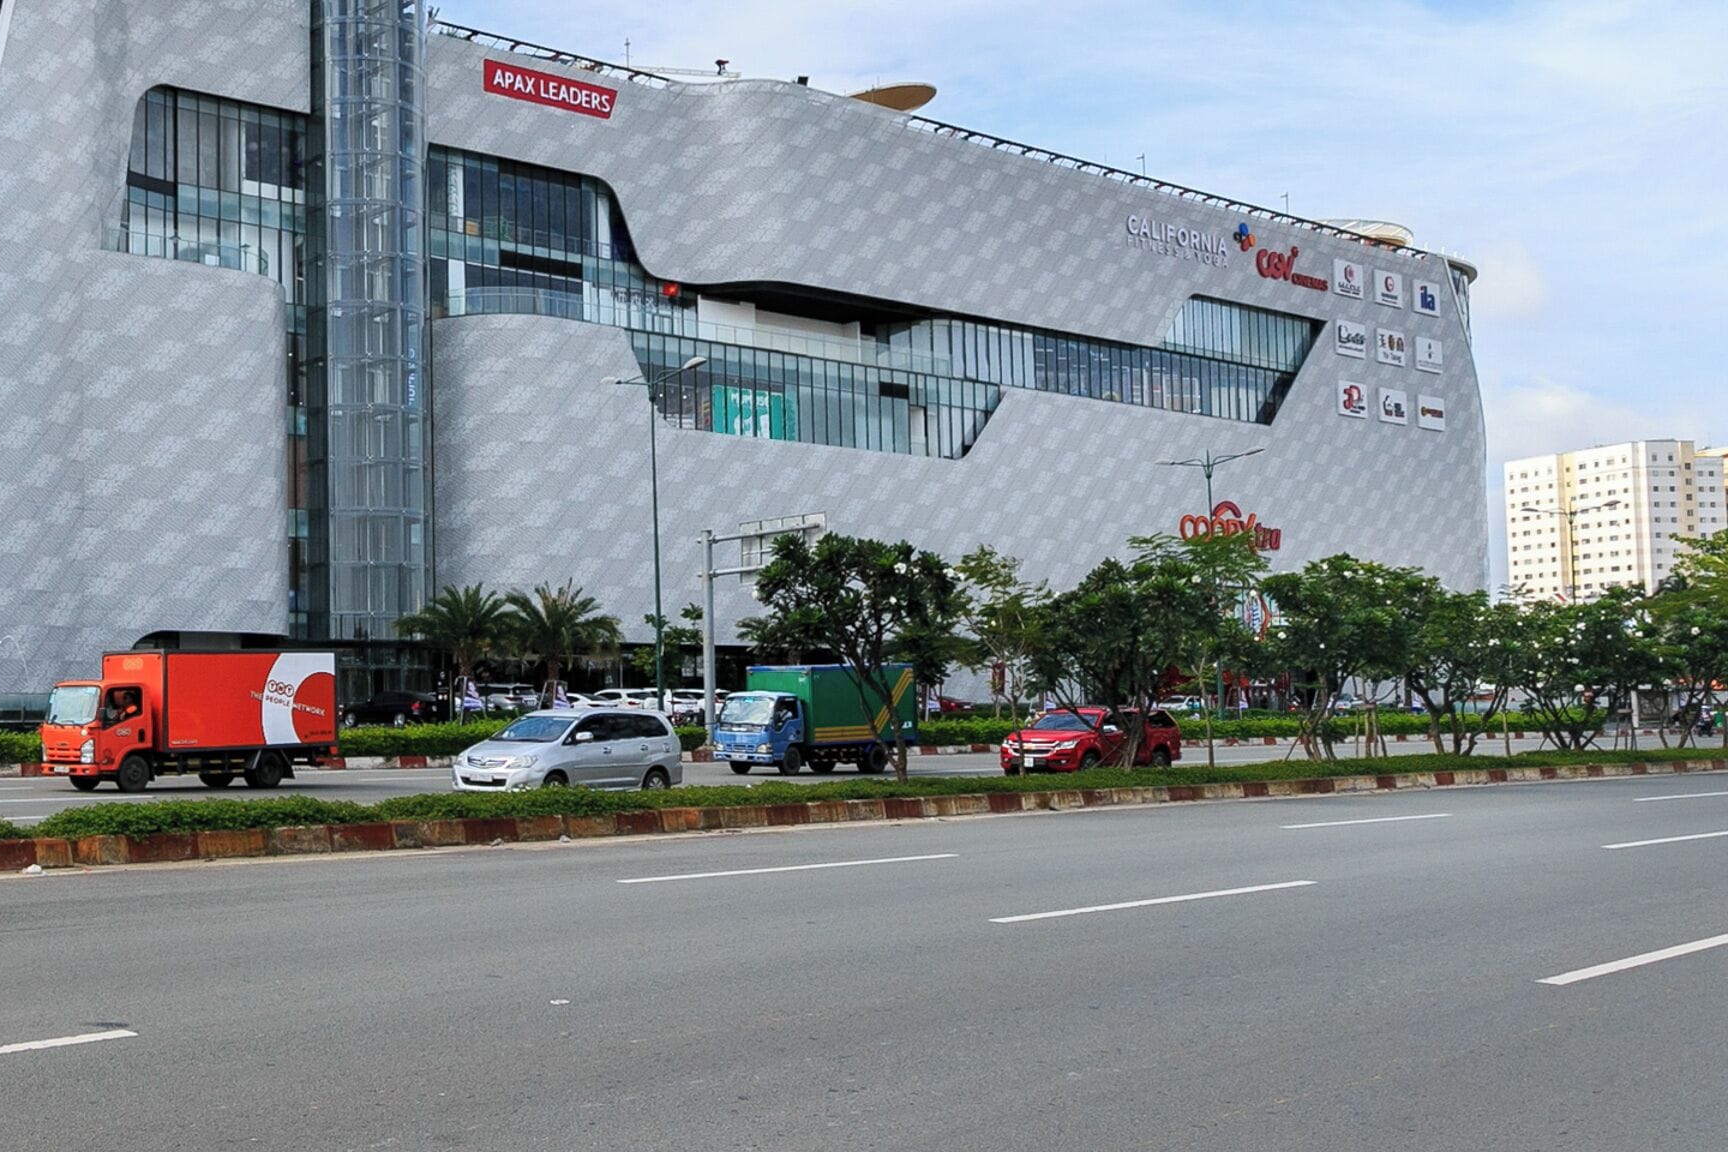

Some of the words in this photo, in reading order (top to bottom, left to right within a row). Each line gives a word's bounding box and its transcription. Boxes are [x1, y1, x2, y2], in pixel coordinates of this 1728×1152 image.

[492, 68, 536, 96] APAX
[539, 78, 612, 113] LEADERS
[1127, 214, 1228, 256] CALIFORNIA
[1127, 237, 1180, 259] FITNESS
[1194, 250, 1229, 269] YOGA
[1256, 248, 1295, 281] CGV
[1419, 285, 1436, 311] ila
[250, 690, 264, 702] THE
[265, 694, 291, 708] PEOPLE
[292, 703, 327, 717] NETWORK
[268, 679, 295, 697] TNT
